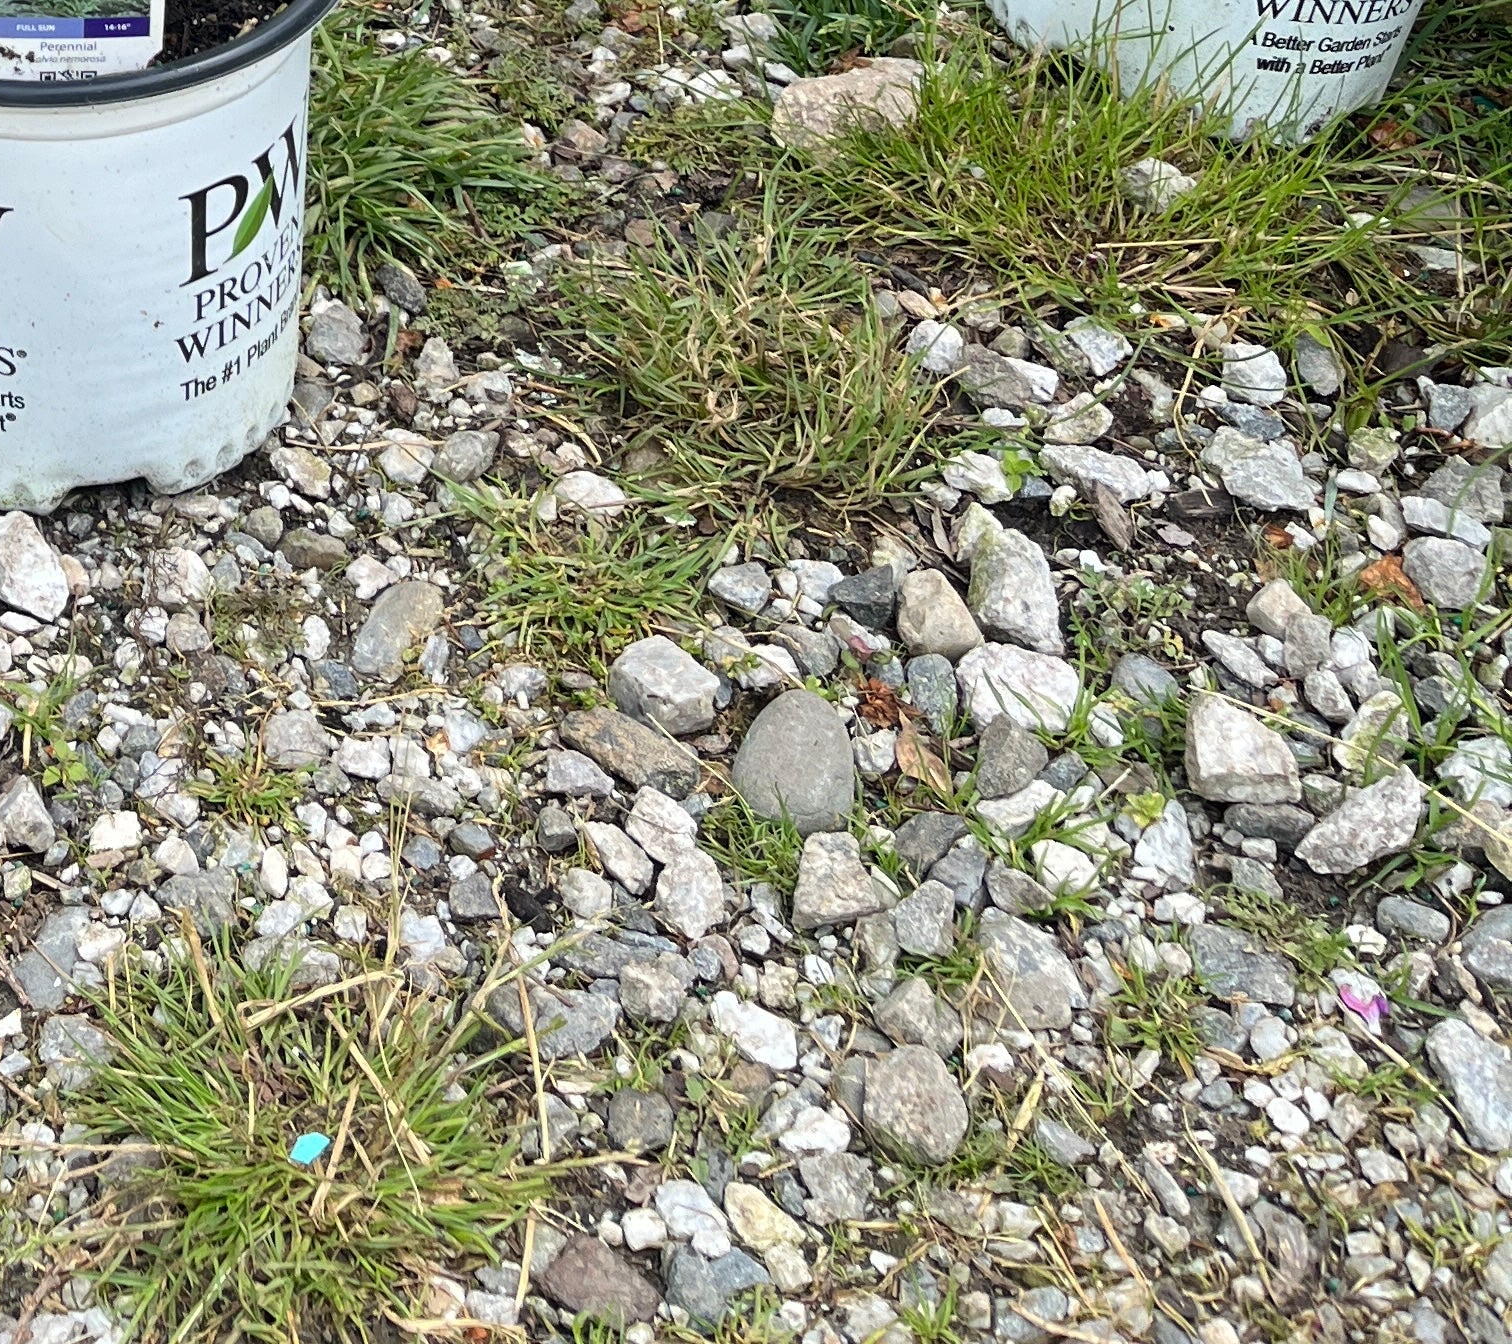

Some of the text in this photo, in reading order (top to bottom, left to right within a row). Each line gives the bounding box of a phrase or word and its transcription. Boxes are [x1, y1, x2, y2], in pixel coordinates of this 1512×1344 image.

[16, 24, 37, 32] FULL
[38, 24, 56, 32] SUN
[40, 41, 97, 52] Perennial
[1261, 31, 1316, 52] Better
[1318, 36, 1371, 53] Garden
[33, 55, 106, 63] alvia nemorosa
[1256, 56, 1292, 74] with
[1295, 62, 1307, 74] a
[1309, 59, 1355, 75] Better
[178, 114, 300, 288] PW
[193, 201, 301, 323] PROVEN
[180, 375, 217, 401] The
[221, 355, 241, 385] #1
[247, 323, 278, 368] Plant
